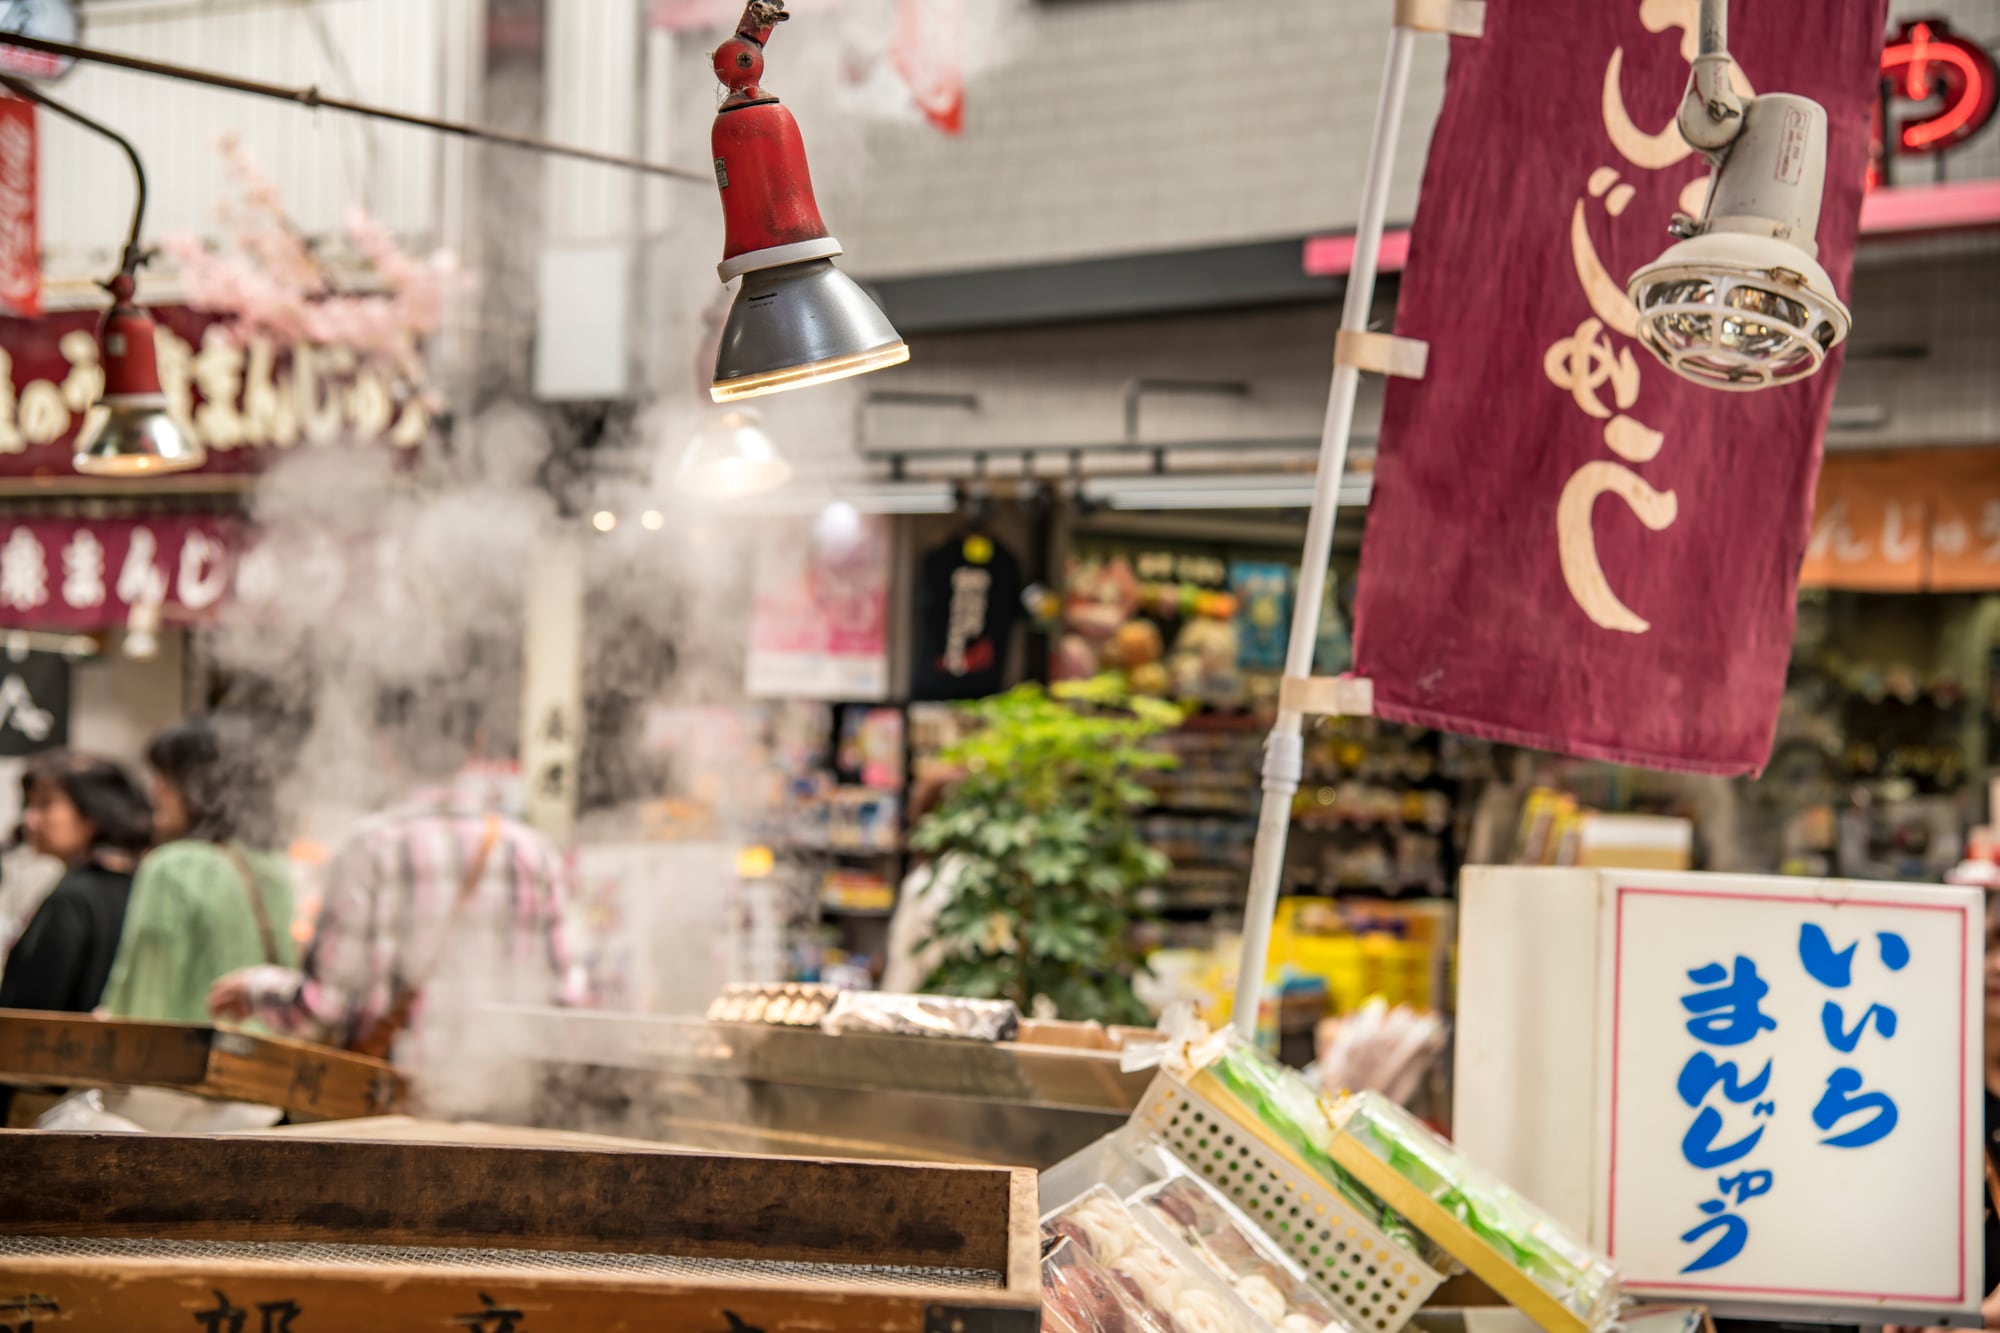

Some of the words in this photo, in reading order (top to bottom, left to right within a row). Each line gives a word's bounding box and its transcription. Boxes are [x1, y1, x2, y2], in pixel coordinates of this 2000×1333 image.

[1677, 954, 1777, 1275] まんじゅう
[1798, 922, 1910, 1149] いいら
